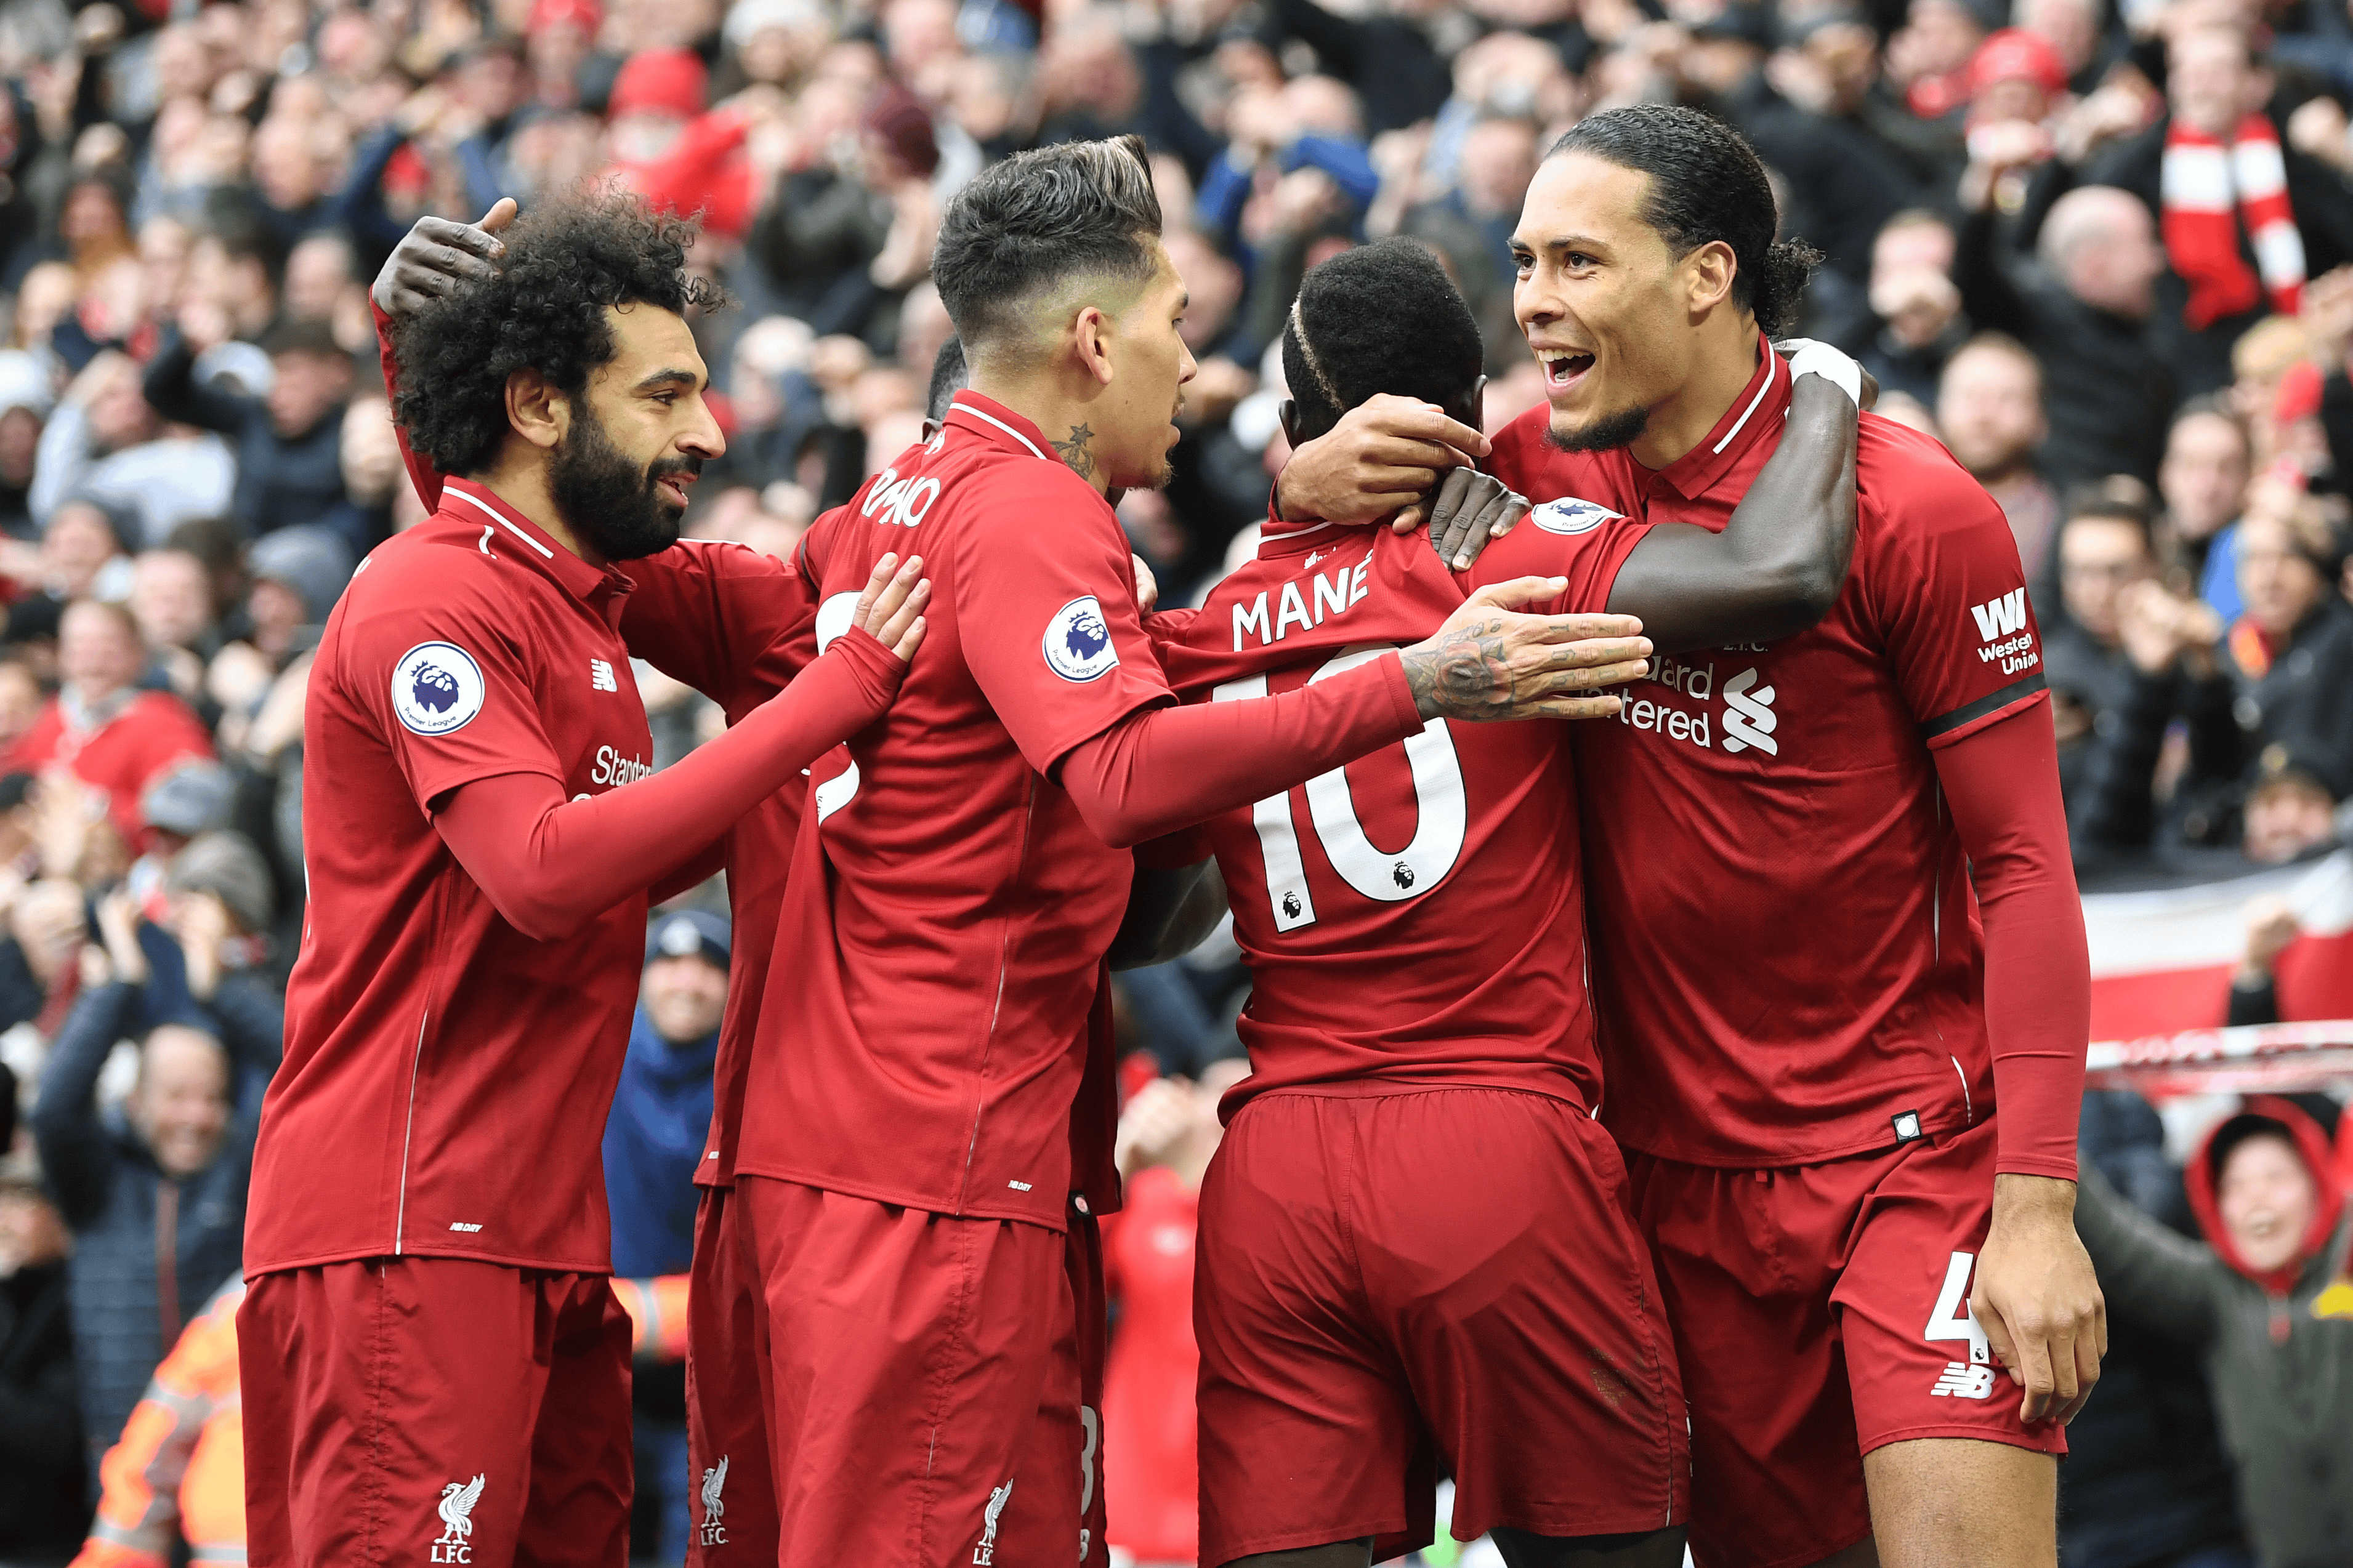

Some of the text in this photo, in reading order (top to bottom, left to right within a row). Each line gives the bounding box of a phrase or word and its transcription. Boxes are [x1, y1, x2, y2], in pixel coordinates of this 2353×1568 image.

[1232, 549, 1374, 653] MANÉ
[1977, 632, 2033, 663] Westen
[1072, 664, 1097, 675] League
[2001, 651, 2038, 675] Union
[427, 716, 457, 727] League
[1924, 1251, 1990, 1364] 4
